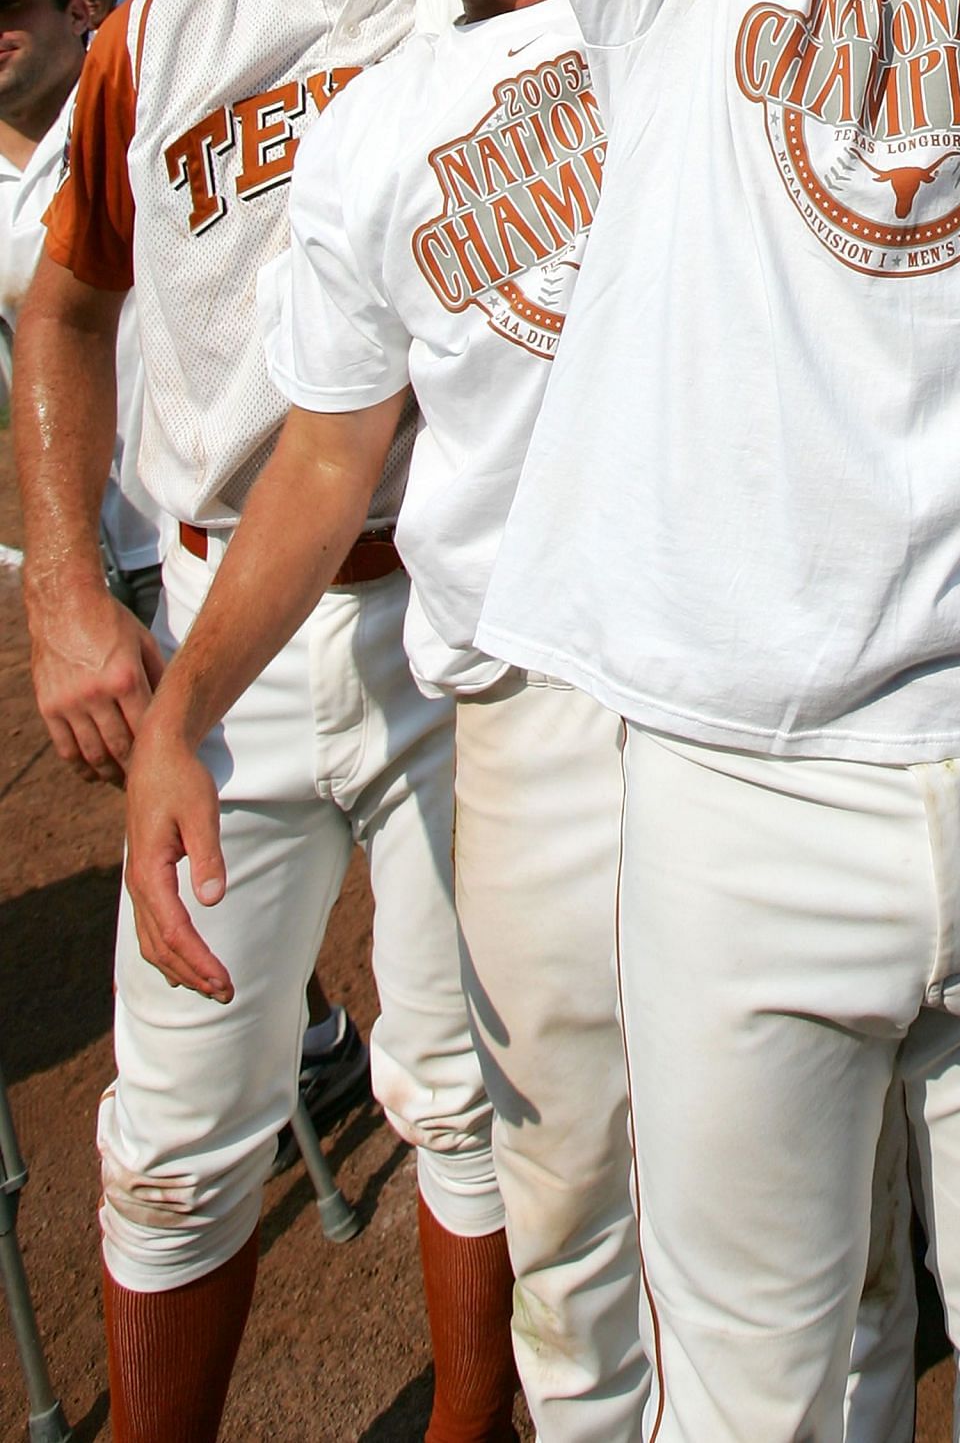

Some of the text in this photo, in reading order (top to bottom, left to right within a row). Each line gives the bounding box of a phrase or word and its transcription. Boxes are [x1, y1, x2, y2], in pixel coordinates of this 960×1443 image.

[503, 61, 583, 117] 2005
[834, 129, 875, 153] TEXAS
[778, 149, 802, 200] NCAA
[804, 203, 873, 264] DIVISION
[878, 252, 888, 268] I
[907, 240, 956, 268] MEN'S
